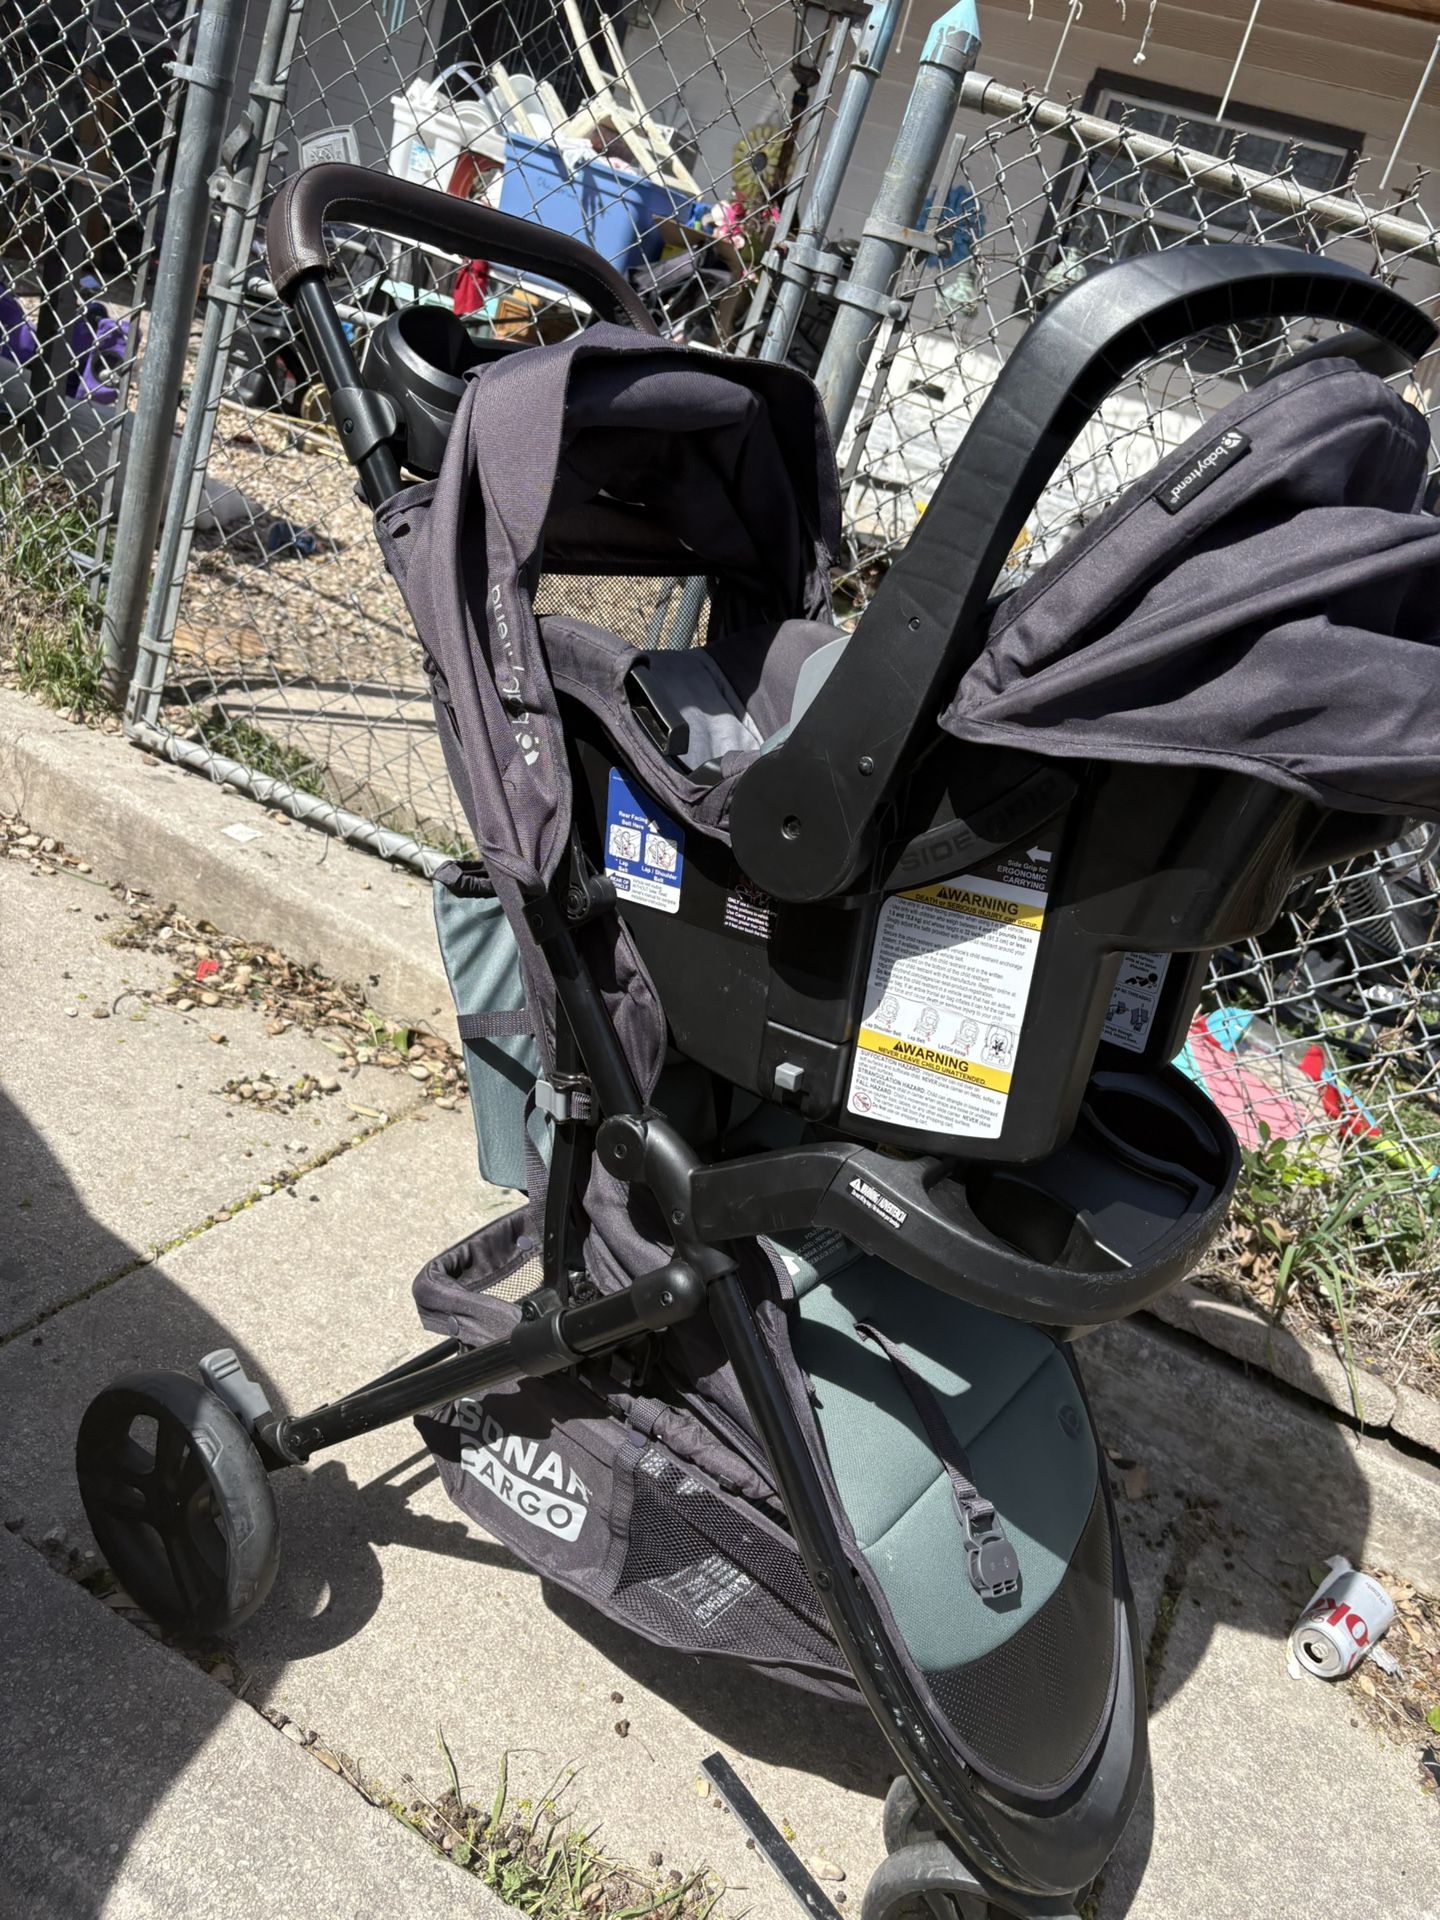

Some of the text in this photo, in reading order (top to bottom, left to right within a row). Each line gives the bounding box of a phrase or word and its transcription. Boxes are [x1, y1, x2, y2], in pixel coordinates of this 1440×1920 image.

[1171, 447, 1228, 500] babytrend
[997, 865, 1048, 882] ERGONOMIC
[1007, 859, 1022, 868] Side
[1023, 862, 1038, 873] Grip
[1003, 875, 1045, 890] CARRYING
[915, 894, 937, 904] DEATH
[947, 901, 976, 913] SERIOUS
[978, 909, 1002, 920] INJURY
[1017, 920, 1038, 928] occur.
[945, 888, 1019, 916] WARNING
[860, 1050, 896, 1065] SUFFOCATION
[878, 1046, 986, 1084] NEVER LEAVE CHILD UNATTENDED.
[902, 1043, 969, 1072] WARNING
[858, 1067, 901, 1085] STRANGULATION
[902, 1082, 925, 1093] HAZARD:
[921, 1076, 936, 1084] NEVER
[962, 1114, 978, 1123] NEVER
